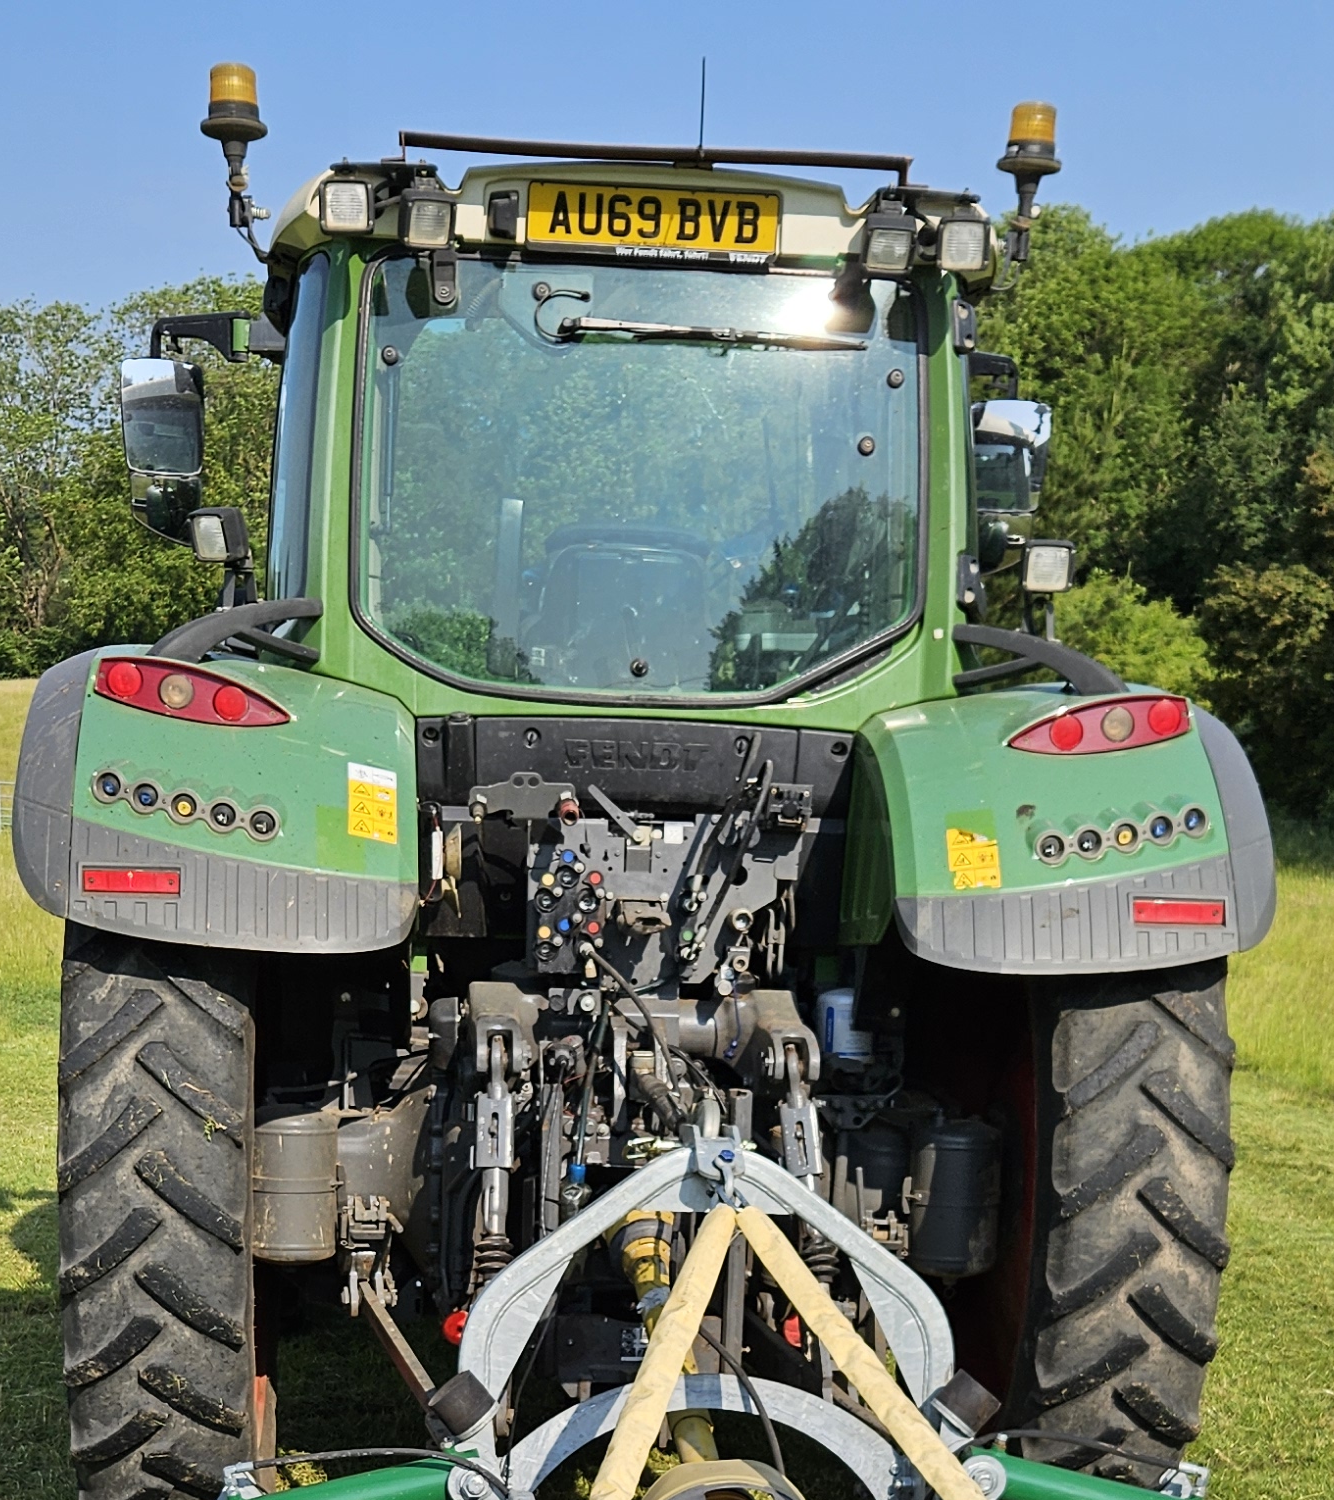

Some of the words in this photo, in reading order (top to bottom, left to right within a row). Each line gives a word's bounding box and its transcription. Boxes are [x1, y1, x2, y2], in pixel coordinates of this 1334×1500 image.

[548, 190, 662, 239] AU69
[676, 197, 760, 244] BVB
[565, 738, 711, 773] FENDT
